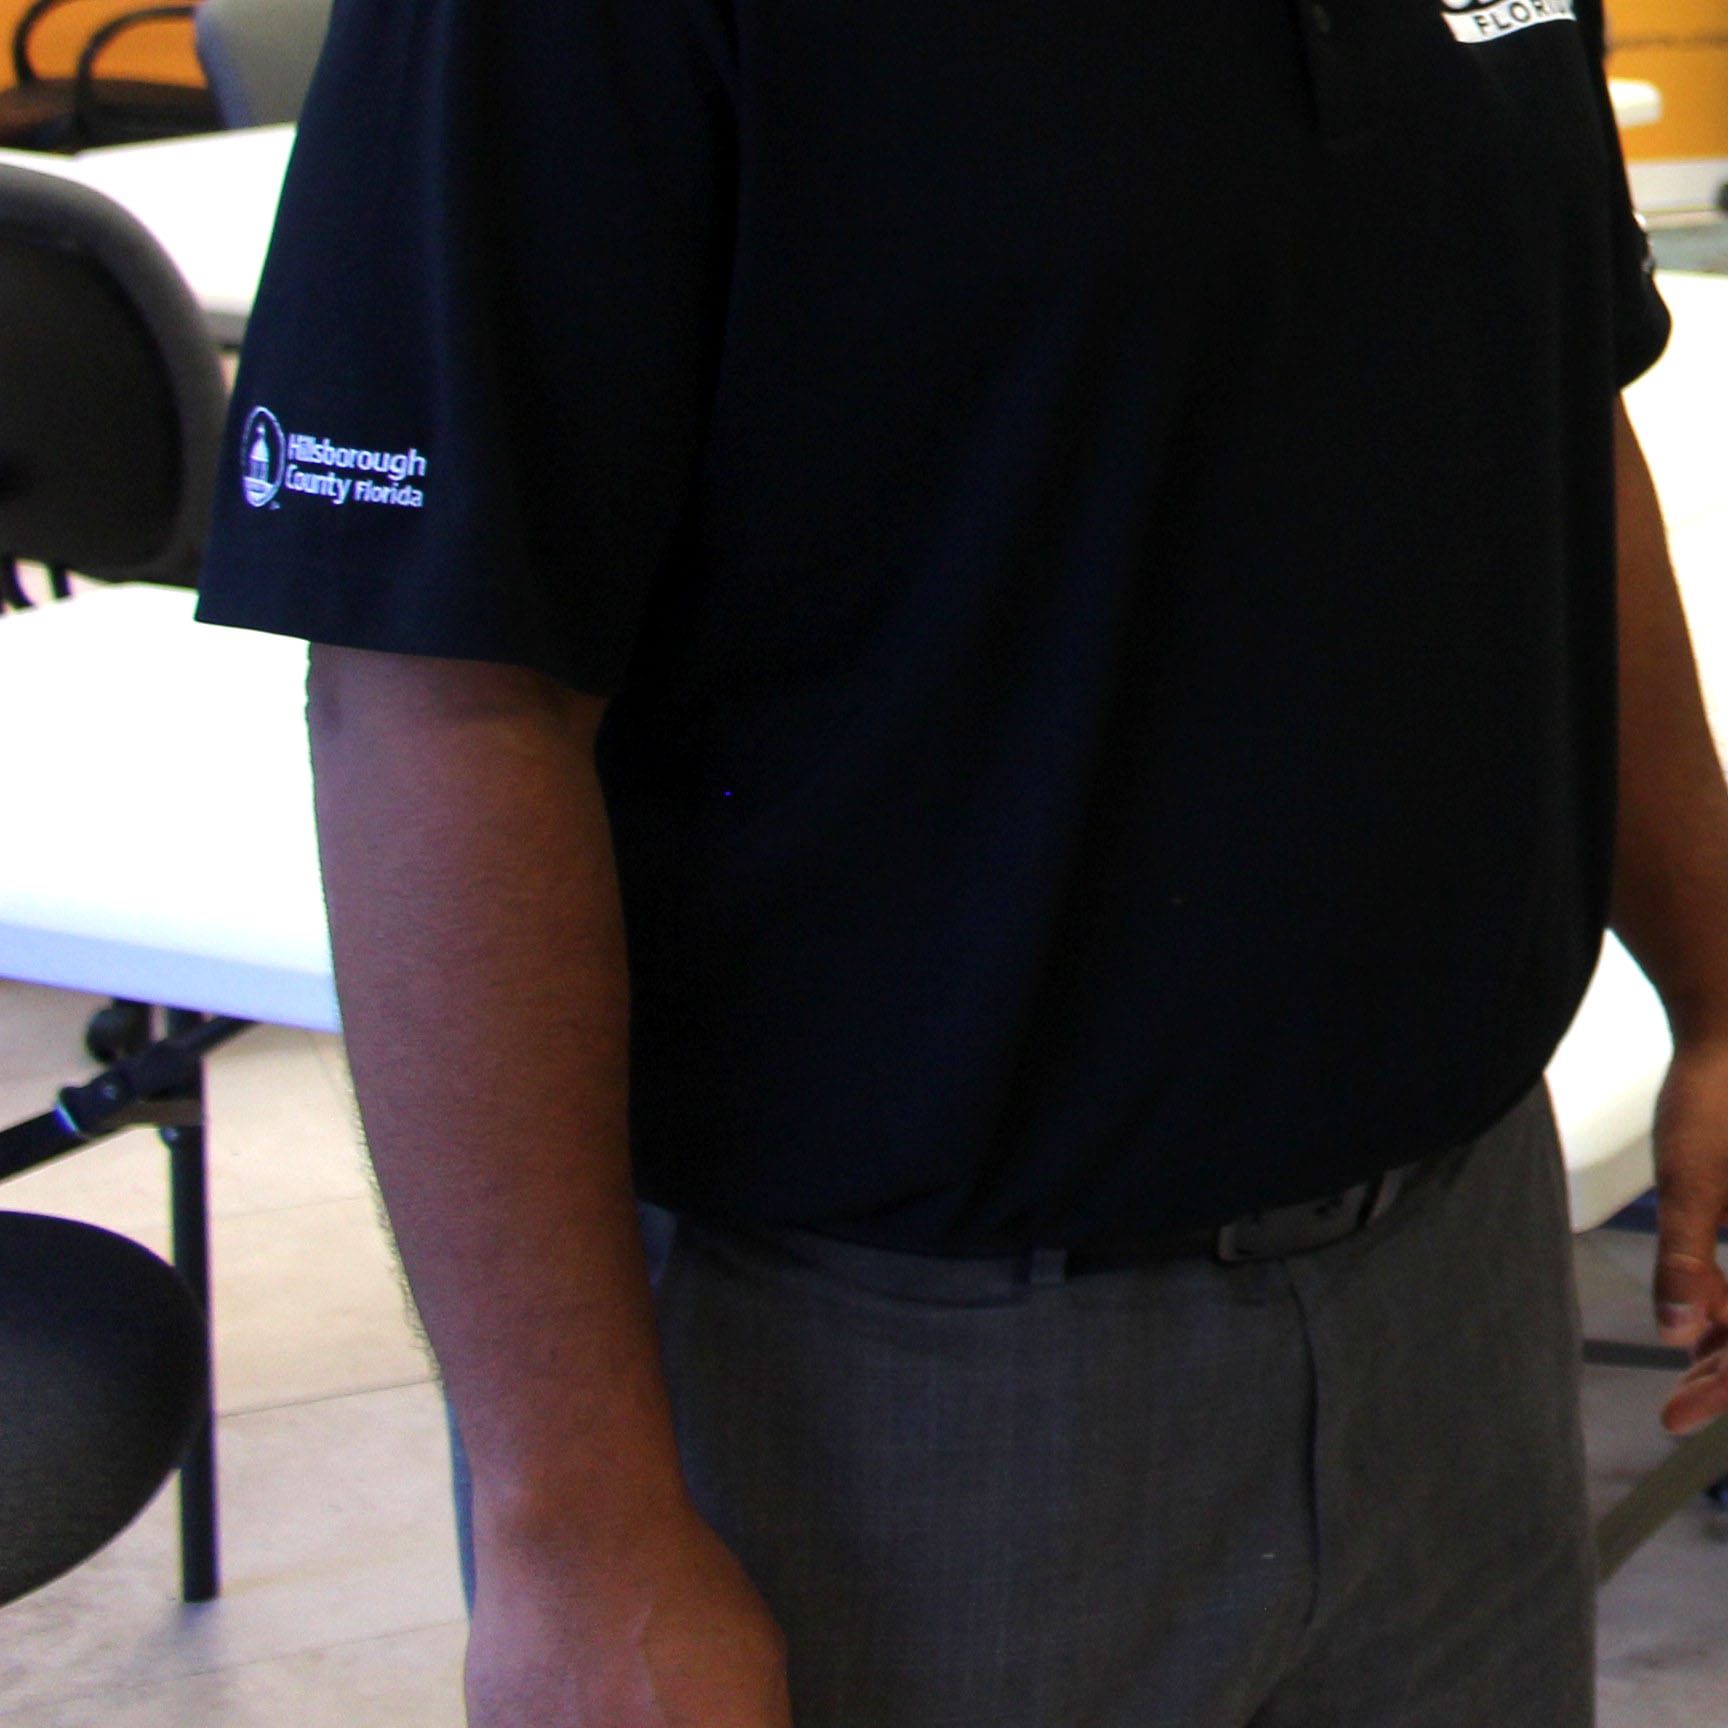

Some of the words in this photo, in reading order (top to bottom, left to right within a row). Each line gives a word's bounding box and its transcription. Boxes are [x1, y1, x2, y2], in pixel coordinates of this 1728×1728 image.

[287, 433, 427, 481] Hillsborough
[285, 464, 351, 505] County
[353, 479, 424, 508] Florida
